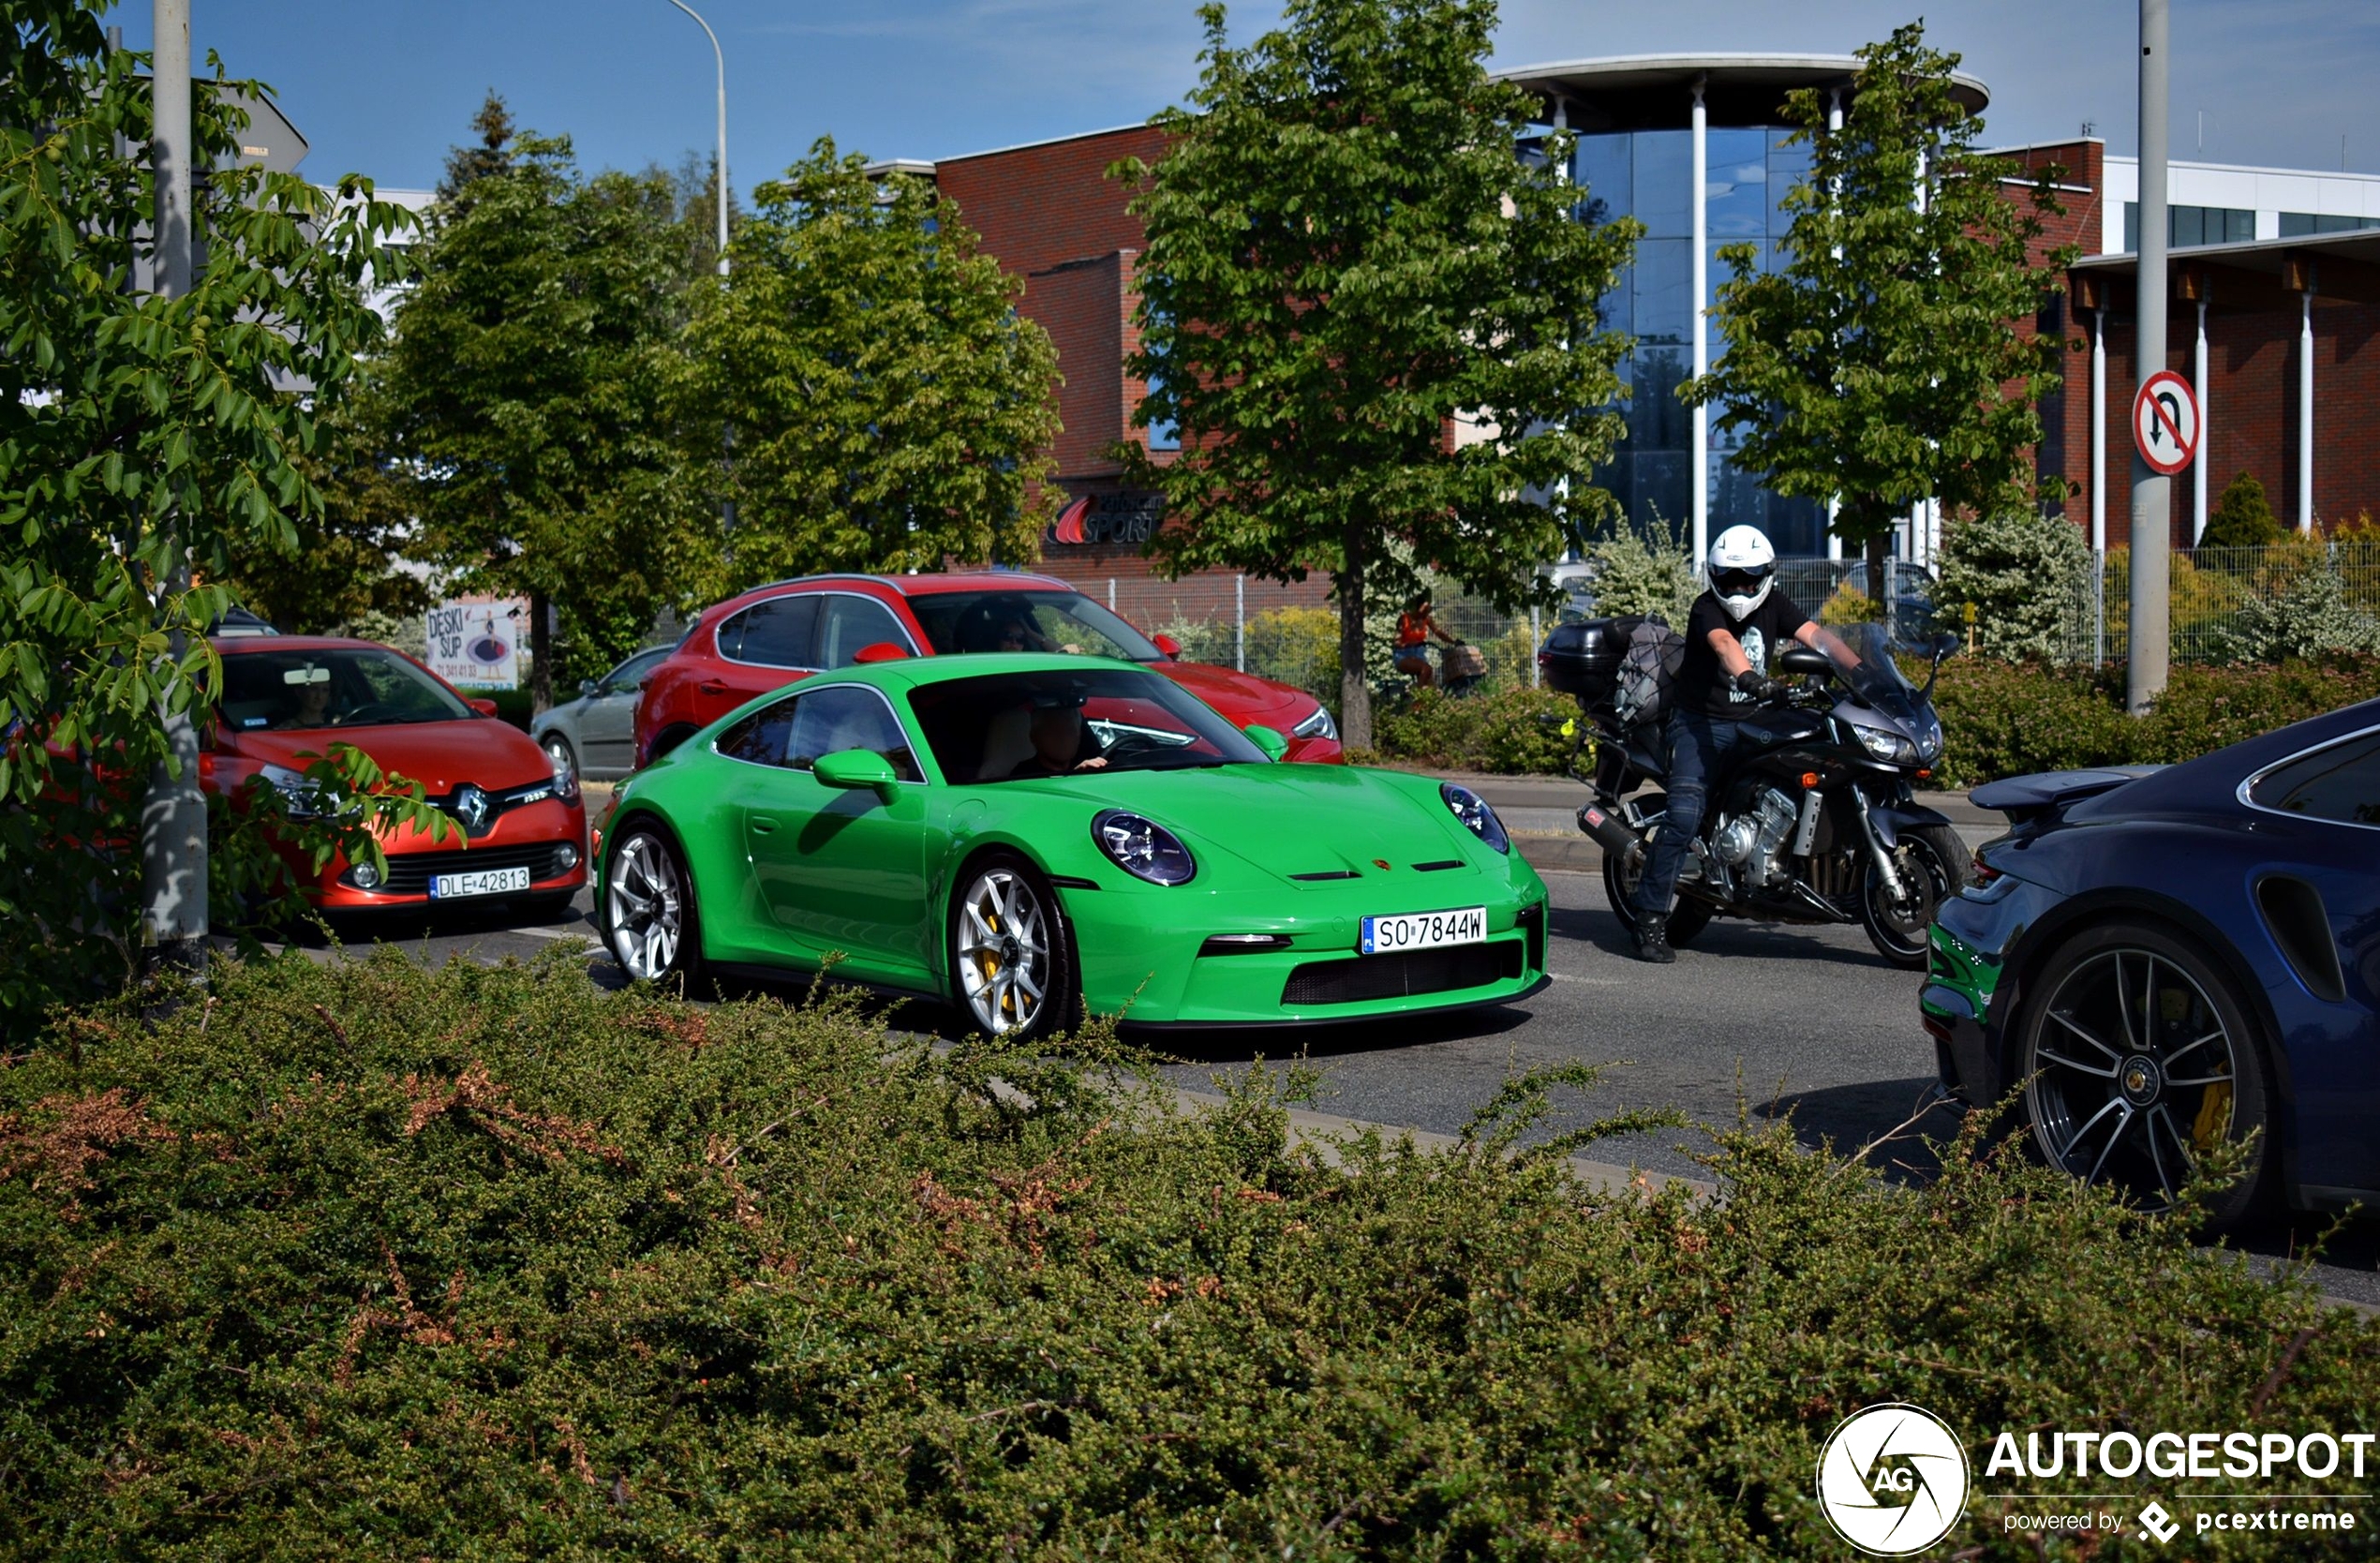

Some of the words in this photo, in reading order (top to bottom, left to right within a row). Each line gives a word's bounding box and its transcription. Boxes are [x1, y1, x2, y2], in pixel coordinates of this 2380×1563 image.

[1084, 513, 1159, 543] SPORT
[428, 608, 463, 638] DESKI
[440, 636, 462, 659] SUP
[439, 875, 473, 897] DLE
[479, 870, 528, 892] 42813
[1364, 938, 1374, 946] PL
[1380, 919, 1409, 946] SO
[1419, 912, 1481, 945] 7844W
